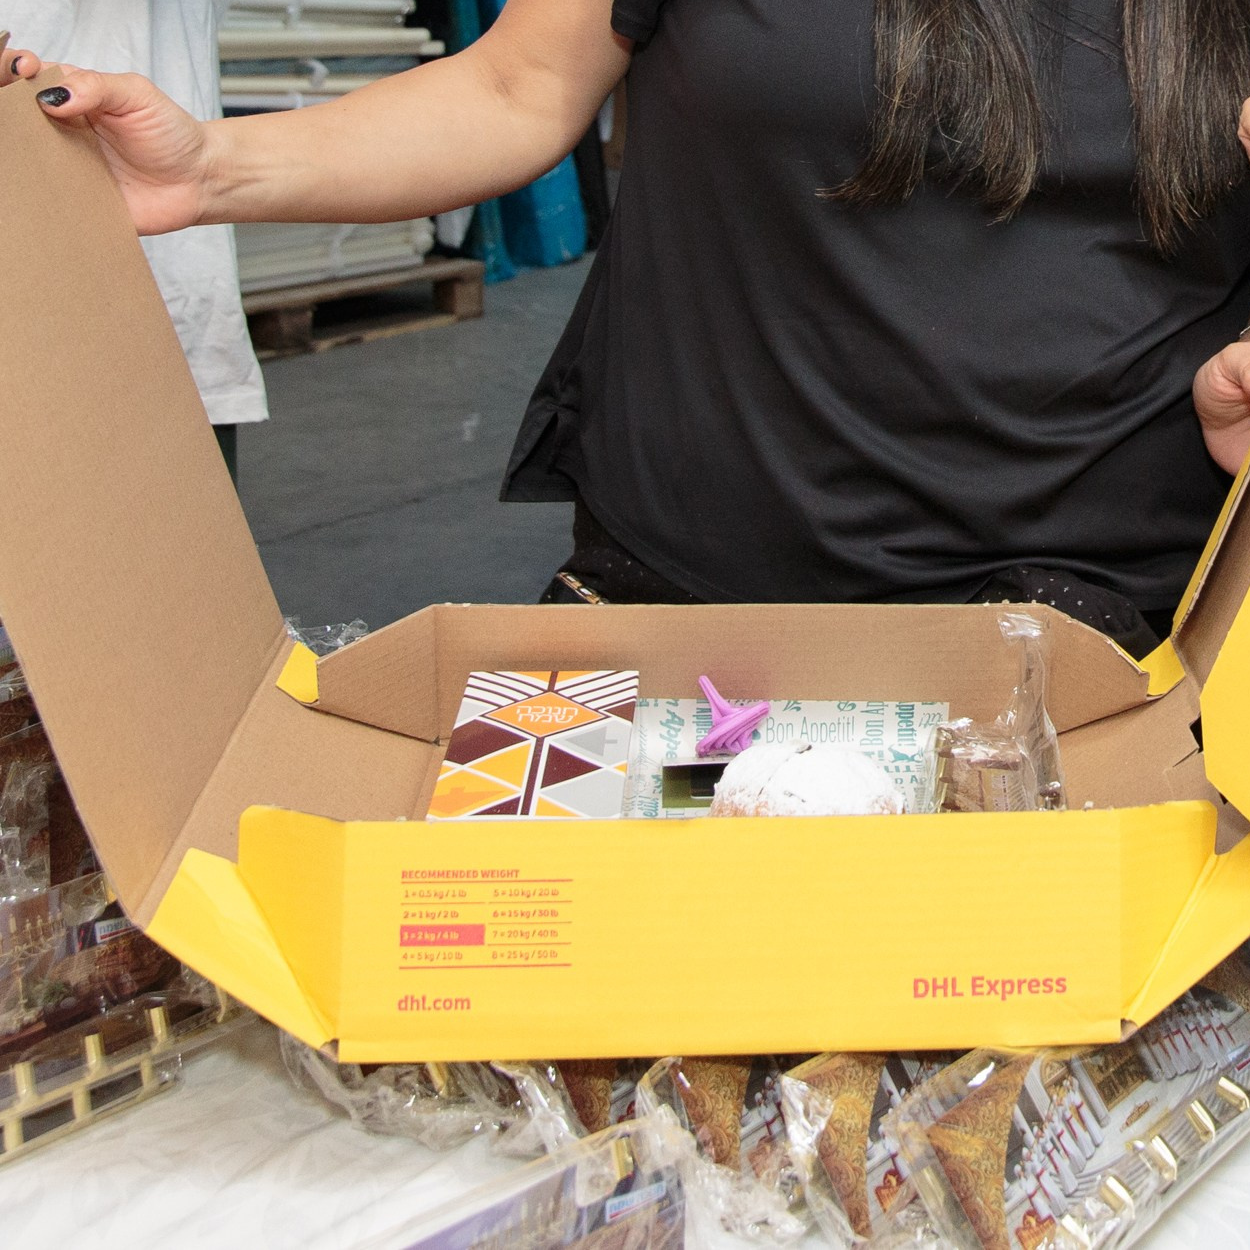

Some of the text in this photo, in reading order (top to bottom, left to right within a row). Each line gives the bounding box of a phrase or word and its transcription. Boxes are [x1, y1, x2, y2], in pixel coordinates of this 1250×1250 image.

[516, 706, 578, 716] חנוכה
[766, 716, 794, 744] Bon
[401, 869, 520, 878] RECOMMENDED WEIGHT
[434, 890, 444, 899] kg
[521, 889, 531, 898] kg
[426, 911, 436, 920] kg
[521, 910, 531, 918] kg
[520, 930, 530, 939] kg
[425, 953, 435, 961] kg
[520, 951, 529, 960] kg
[913, 976, 1067, 1001] DHL Express
[398, 995, 471, 1011] dhl.com
